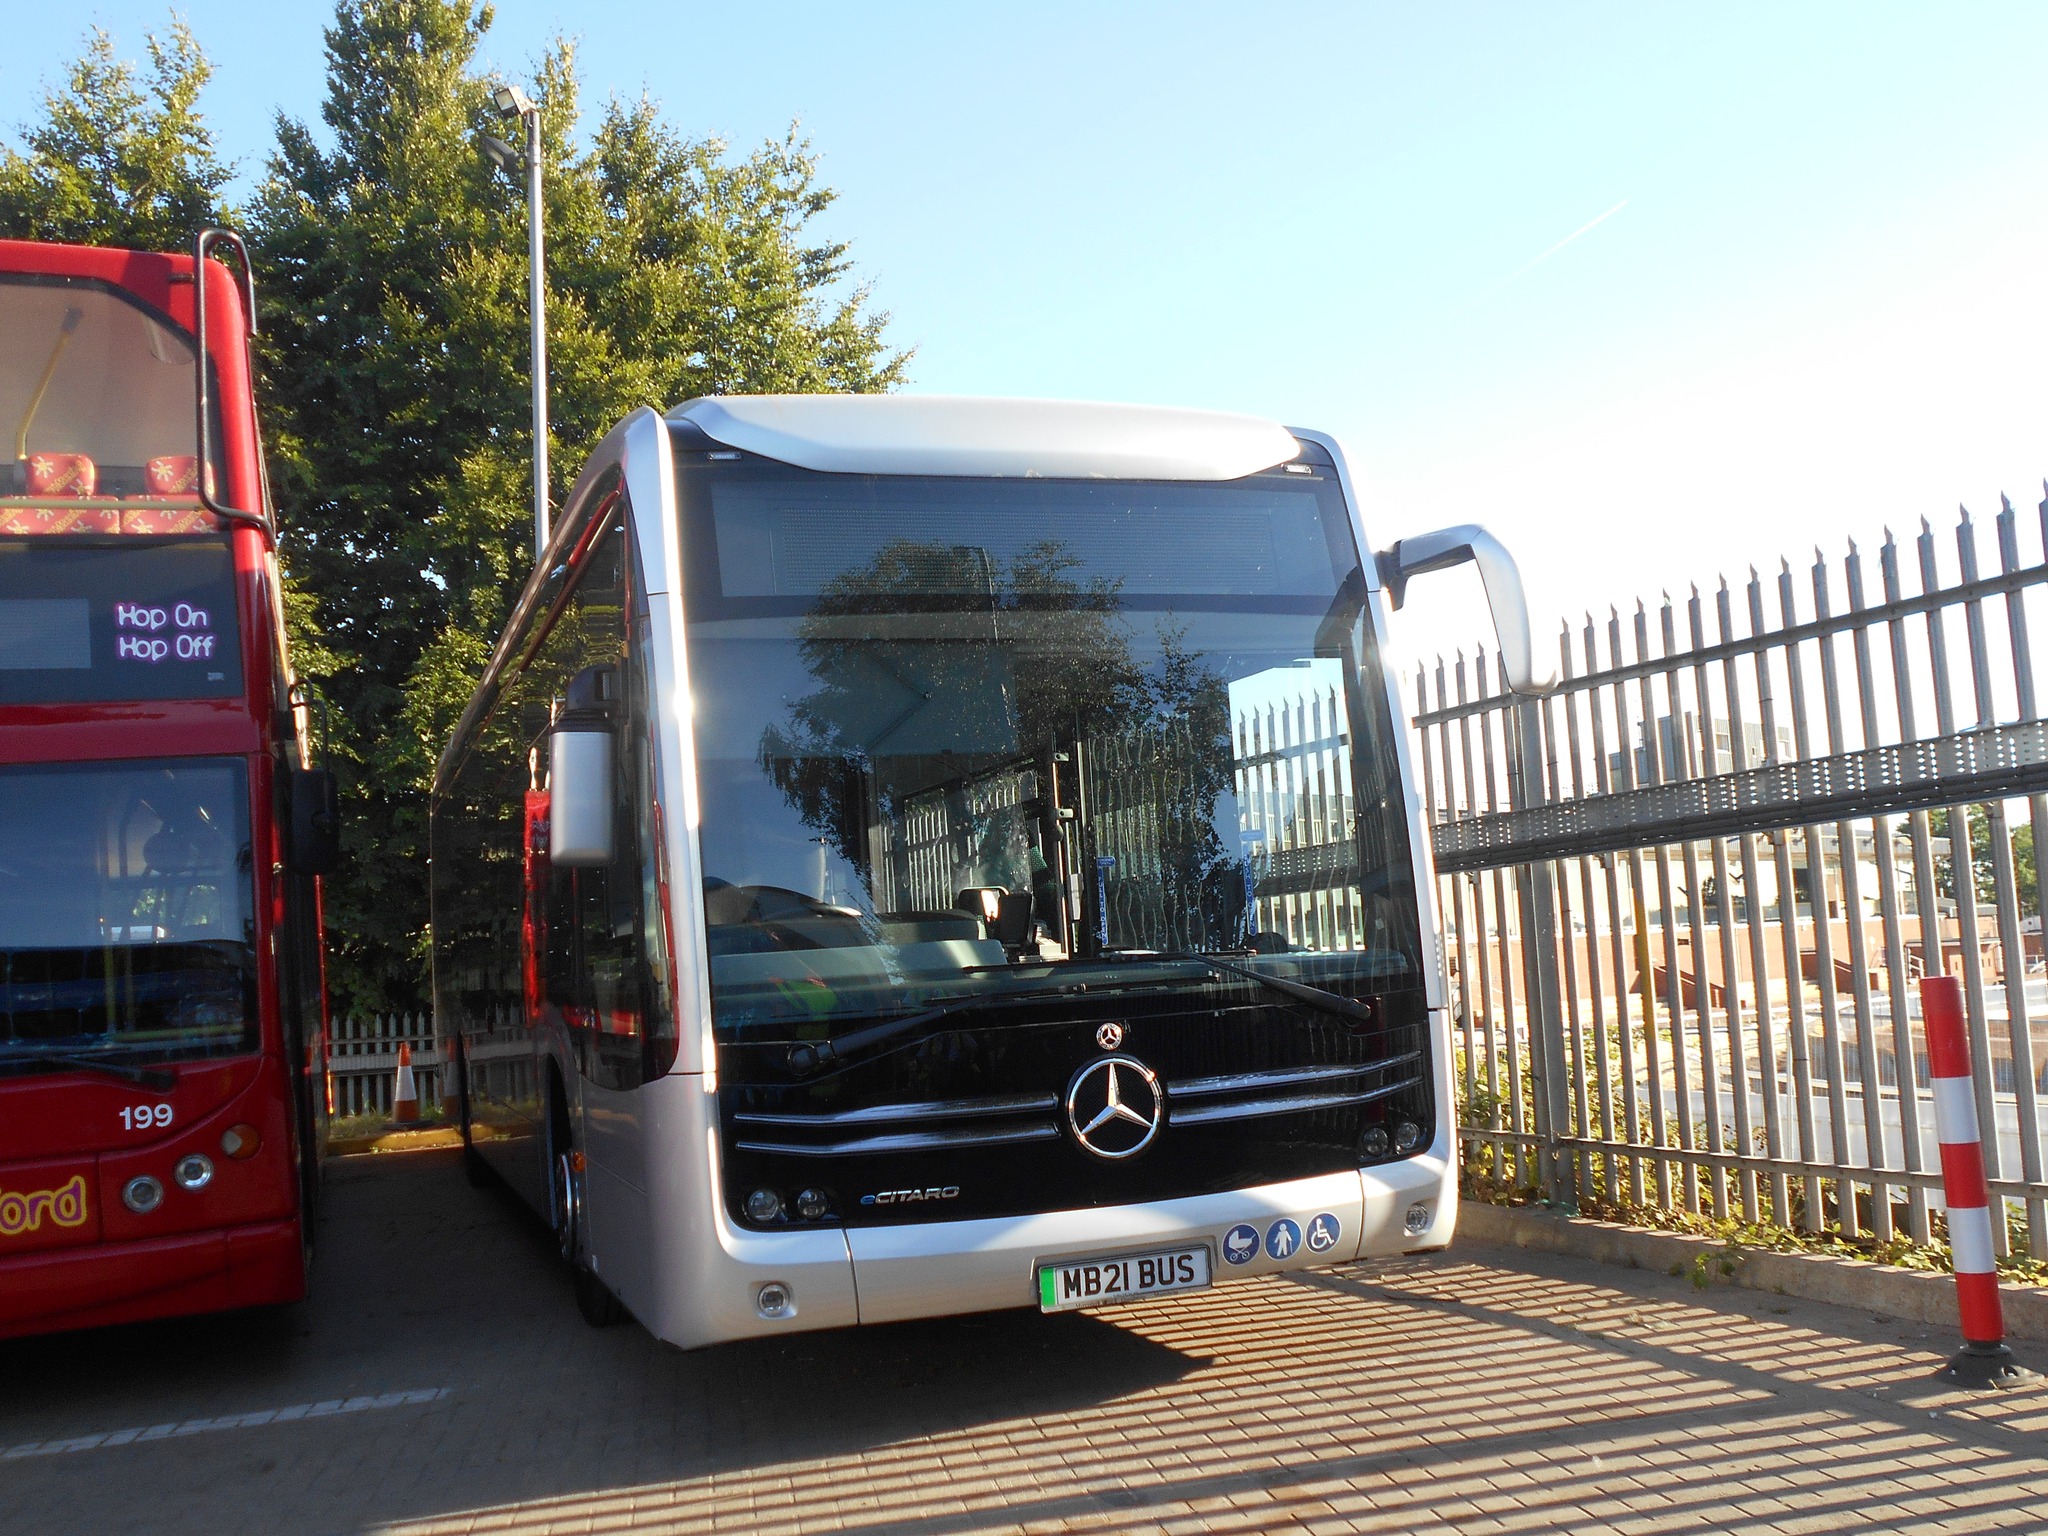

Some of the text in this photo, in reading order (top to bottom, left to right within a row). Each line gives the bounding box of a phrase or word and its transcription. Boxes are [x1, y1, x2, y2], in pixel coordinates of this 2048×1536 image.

[117, 602, 208, 630] Hop On
[118, 633, 214, 662] Hop Off
[119, 1103, 174, 1131] 199
[0, 1175, 87, 1235] ord
[860, 1185, 960, 1205] eCITARO
[1063, 1261, 1130, 1300] MB21
[1138, 1254, 1196, 1289] BUS
